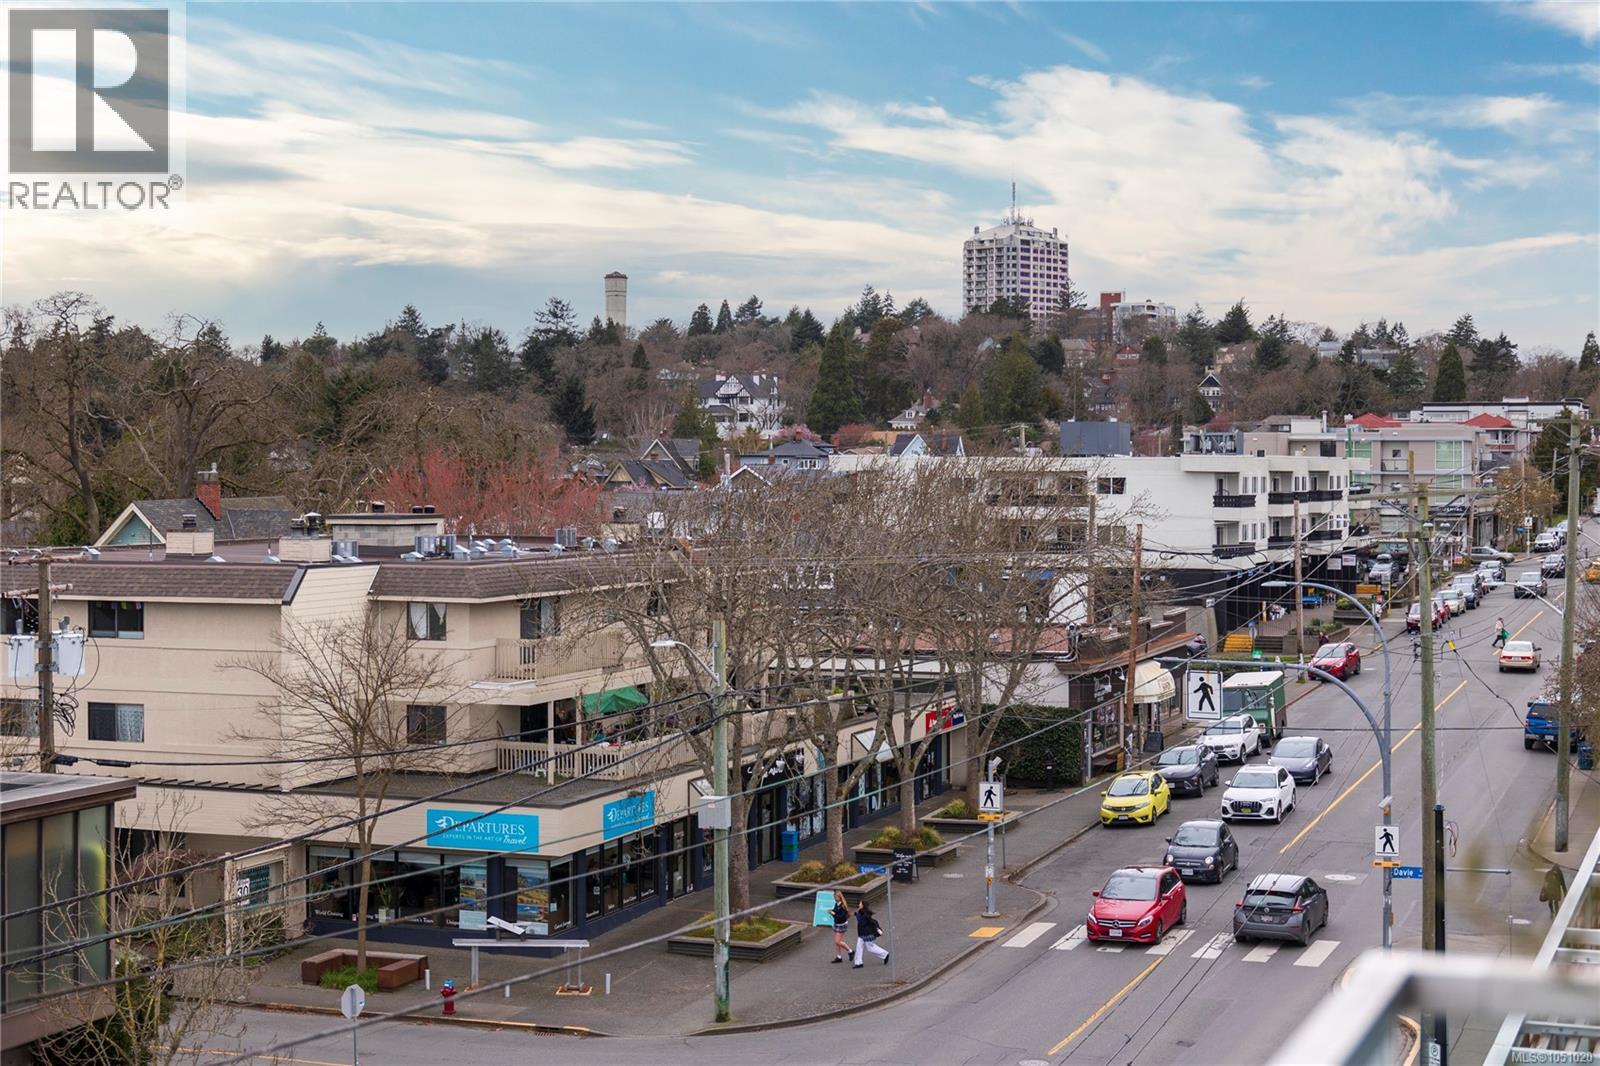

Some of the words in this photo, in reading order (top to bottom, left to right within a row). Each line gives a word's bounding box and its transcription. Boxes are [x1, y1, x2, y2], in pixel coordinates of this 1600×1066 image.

[436, 816, 525, 835] DEPARTURES
[503, 834, 527, 845] Travel
[1393, 868, 1414, 877] Davie
